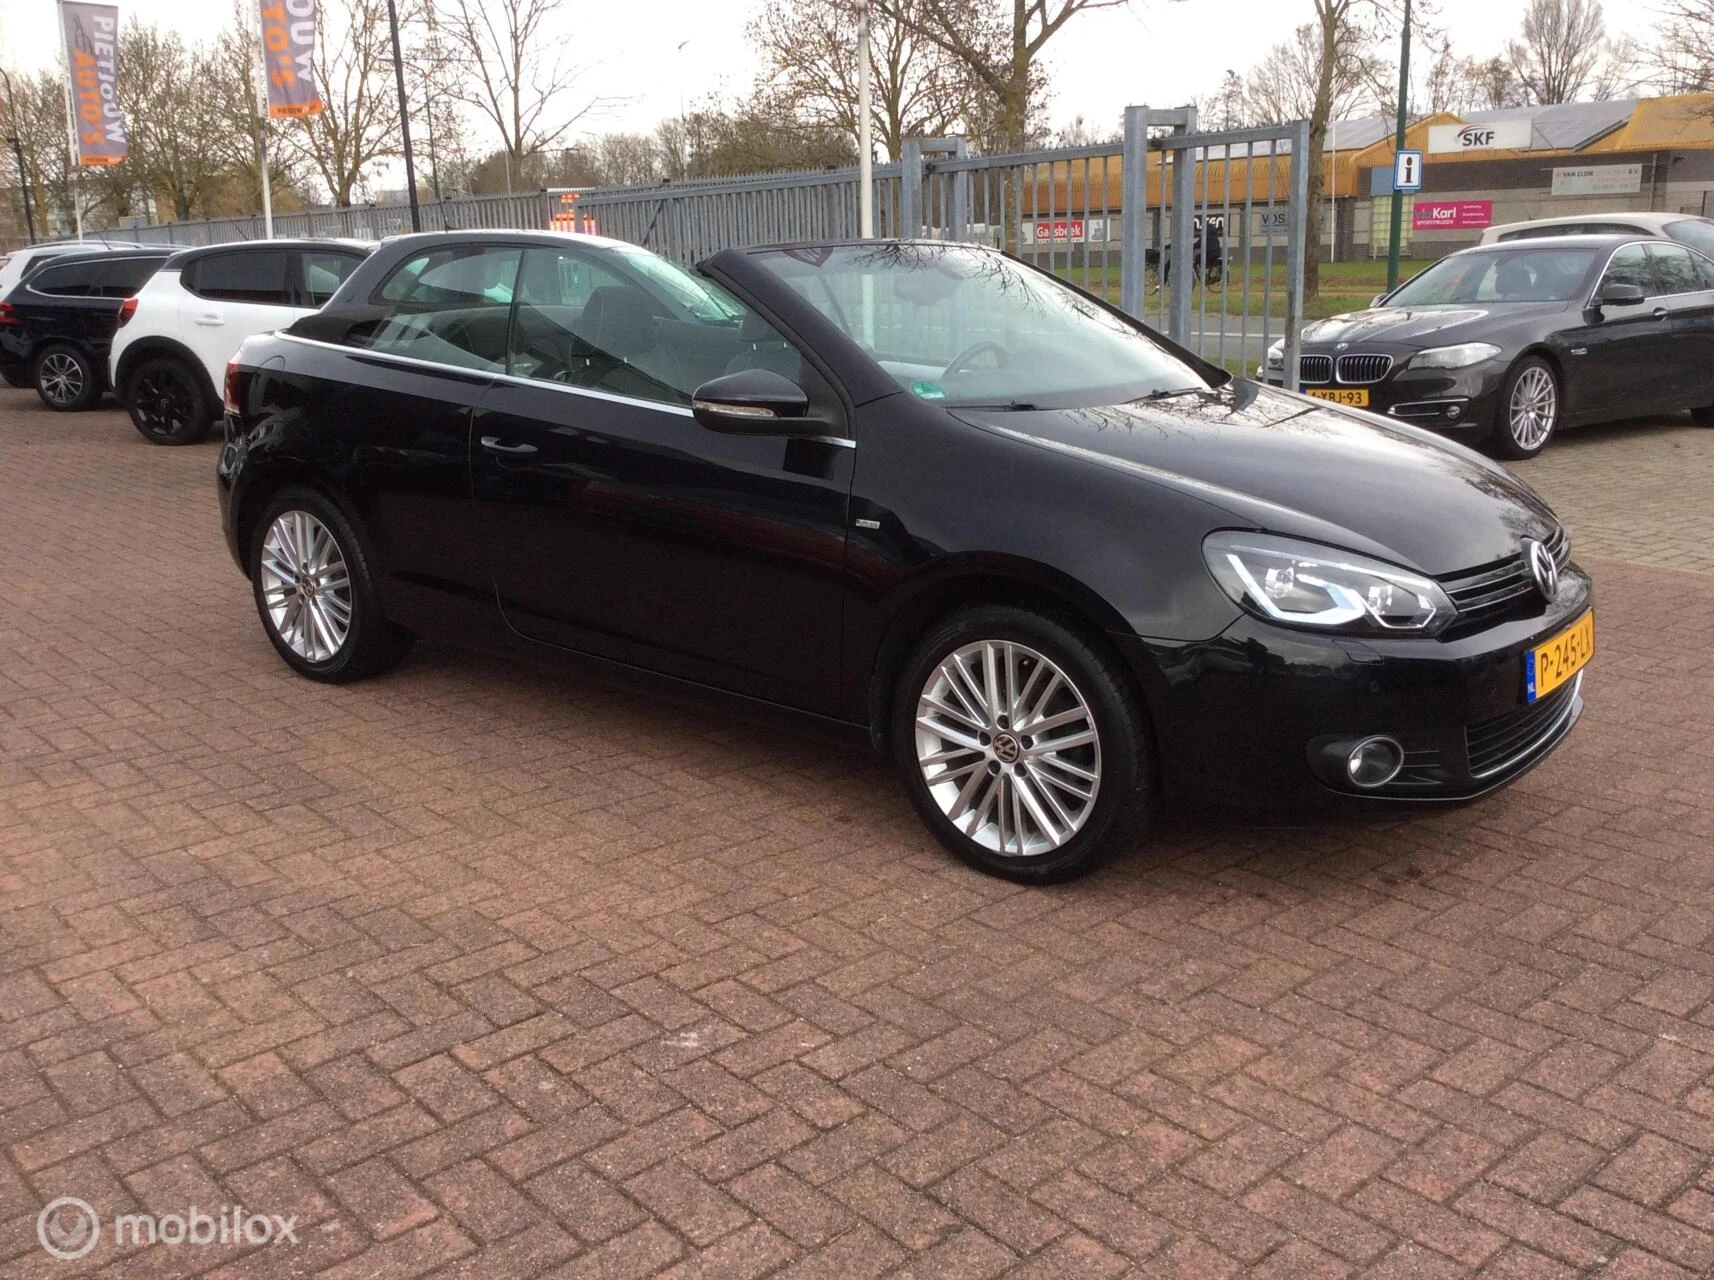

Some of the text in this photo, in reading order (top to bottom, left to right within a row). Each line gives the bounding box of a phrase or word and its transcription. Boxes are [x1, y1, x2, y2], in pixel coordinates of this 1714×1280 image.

[73, 50, 105, 145] AUTO'S
[1462, 131, 1495, 147] SKF
[1541, 623, 1591, 688] P-245-LX
